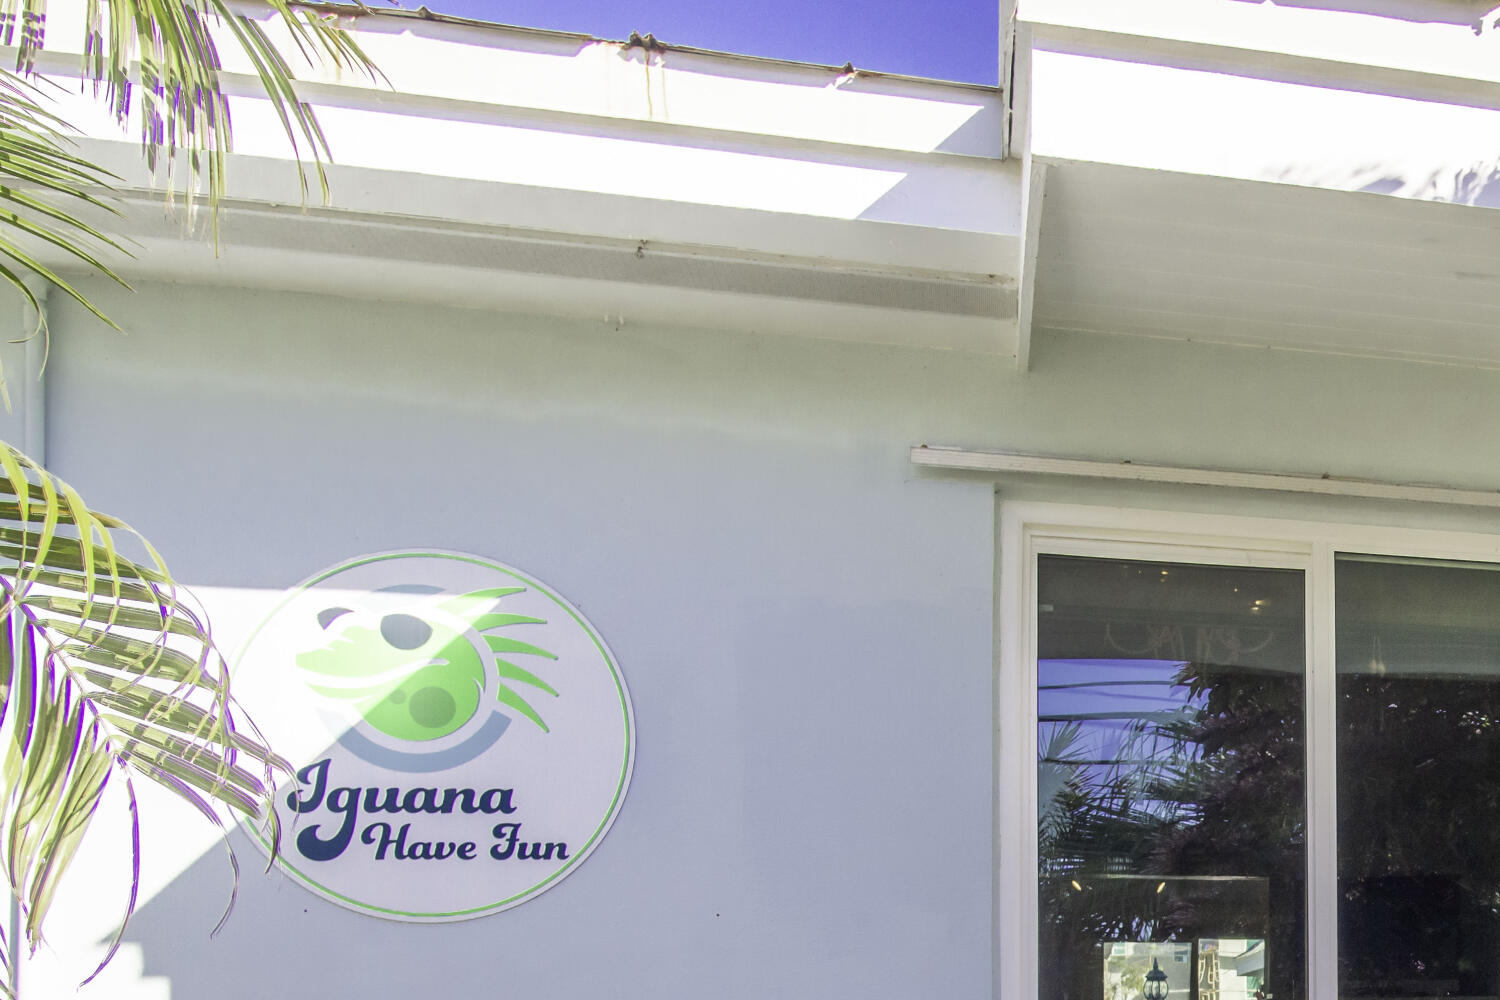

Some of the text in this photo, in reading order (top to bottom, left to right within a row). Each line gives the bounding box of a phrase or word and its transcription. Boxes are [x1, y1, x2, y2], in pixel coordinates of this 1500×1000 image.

[287, 758, 518, 862] Iguana
[361, 822, 570, 861] Have Fun
